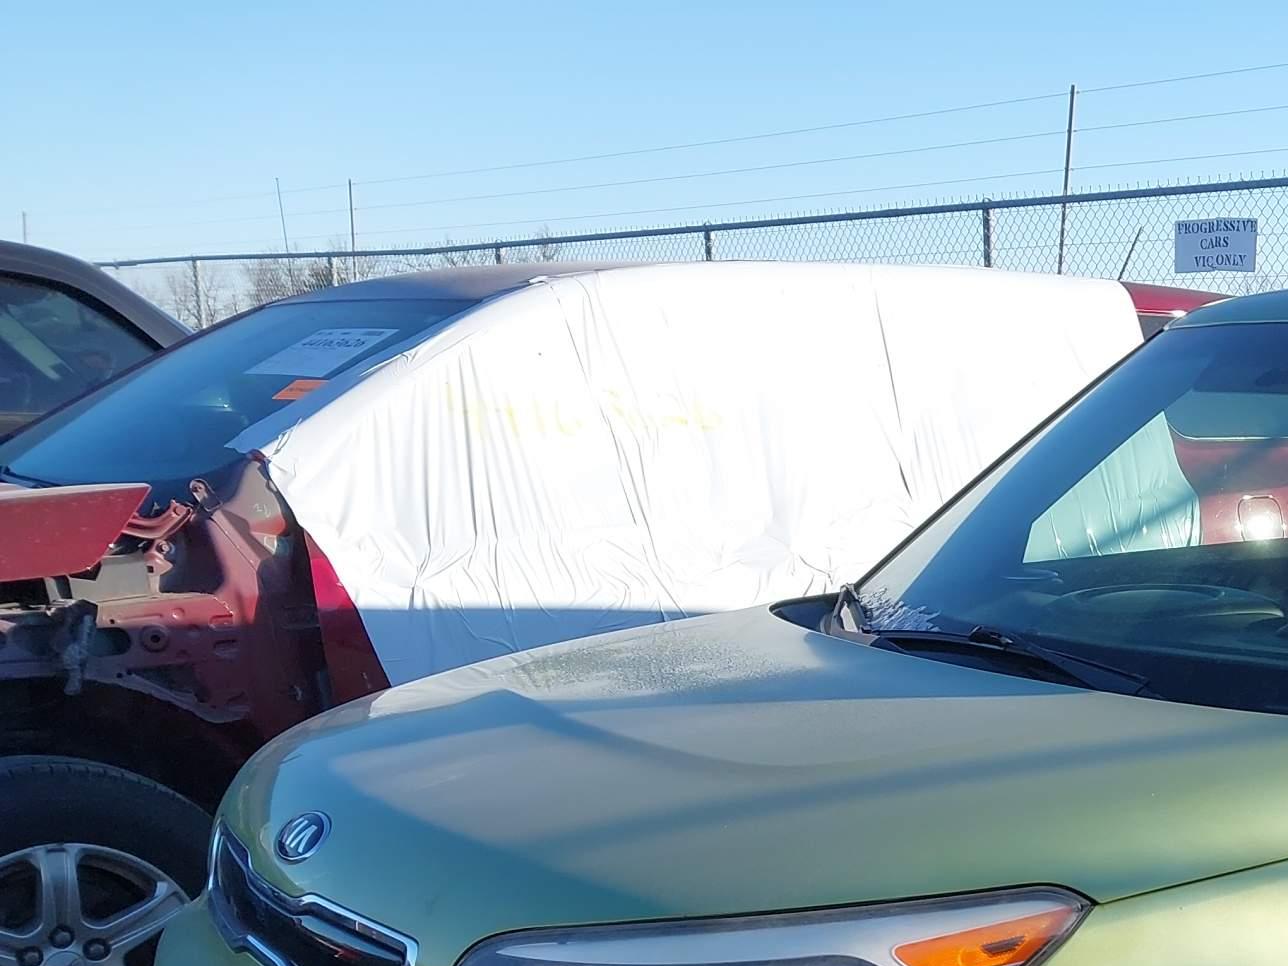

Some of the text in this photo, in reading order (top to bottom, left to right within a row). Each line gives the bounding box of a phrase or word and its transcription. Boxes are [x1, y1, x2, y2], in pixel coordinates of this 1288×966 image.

[1177, 219, 1257, 234] PROGRESSIVE
[1199, 236, 1230, 249] CARS
[1216, 254, 1247, 266] ONLY
